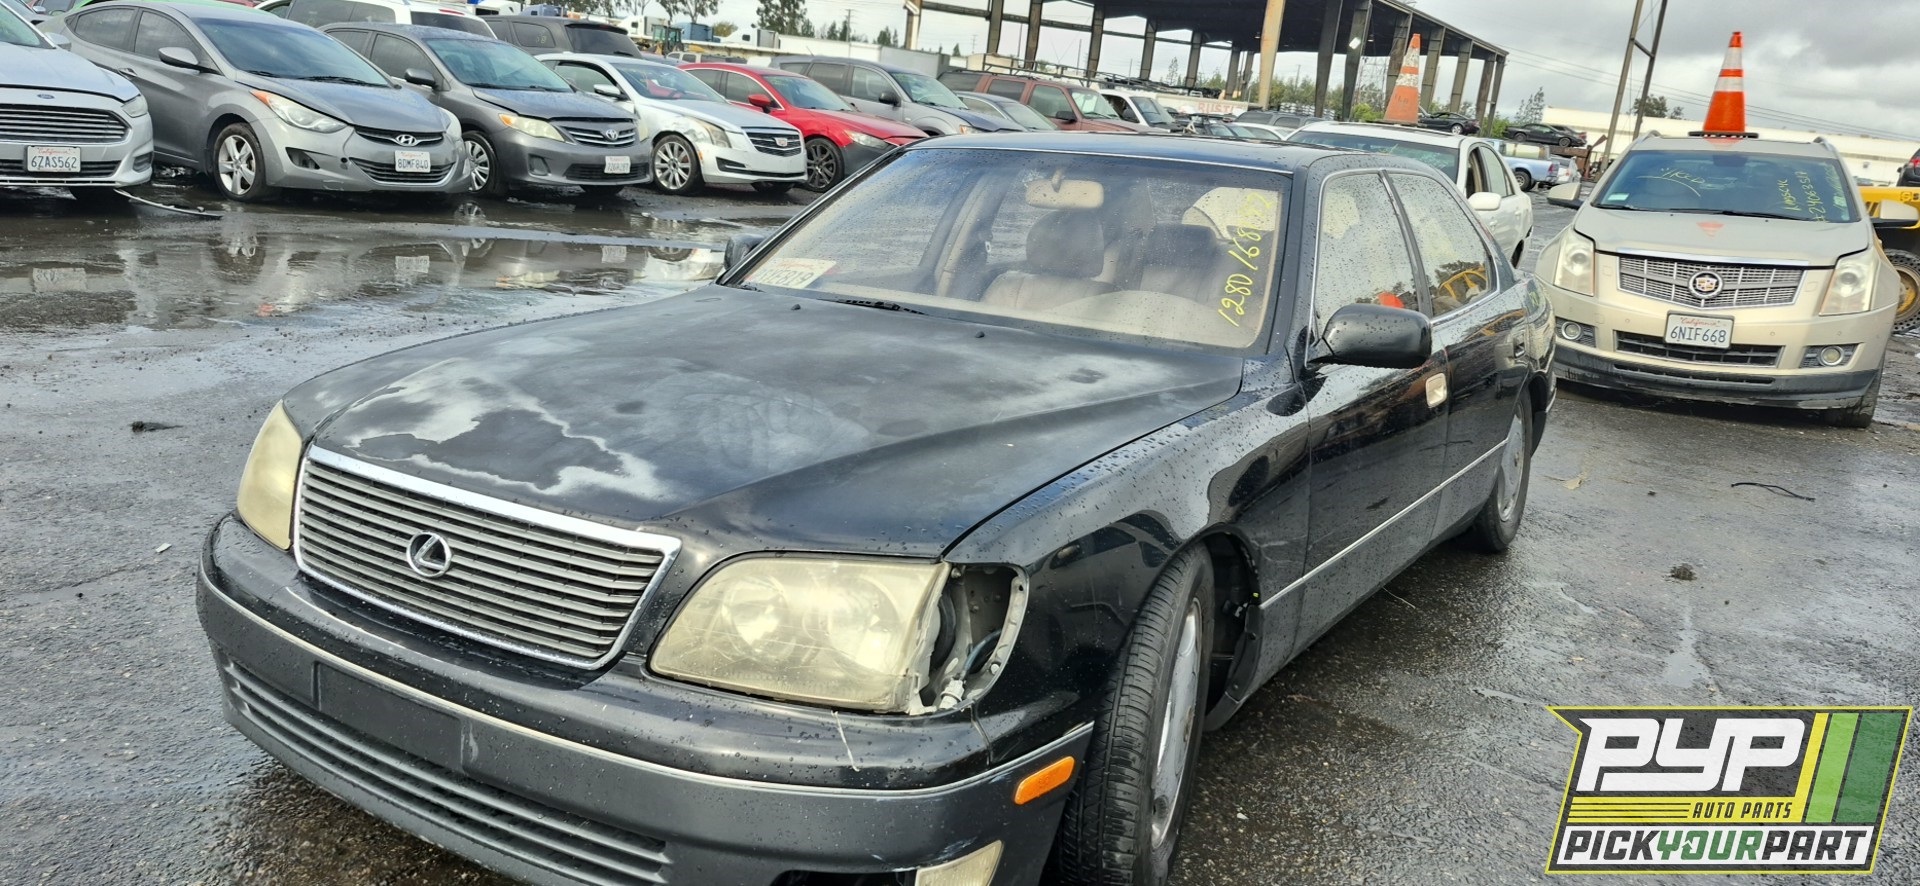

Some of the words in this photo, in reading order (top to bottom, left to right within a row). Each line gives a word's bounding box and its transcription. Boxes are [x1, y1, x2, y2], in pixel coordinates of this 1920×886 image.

[31, 155, 77, 169] 6ZAS562
[1681, 317, 1717, 327] California
[1670, 325, 1727, 343] 6NIF668
